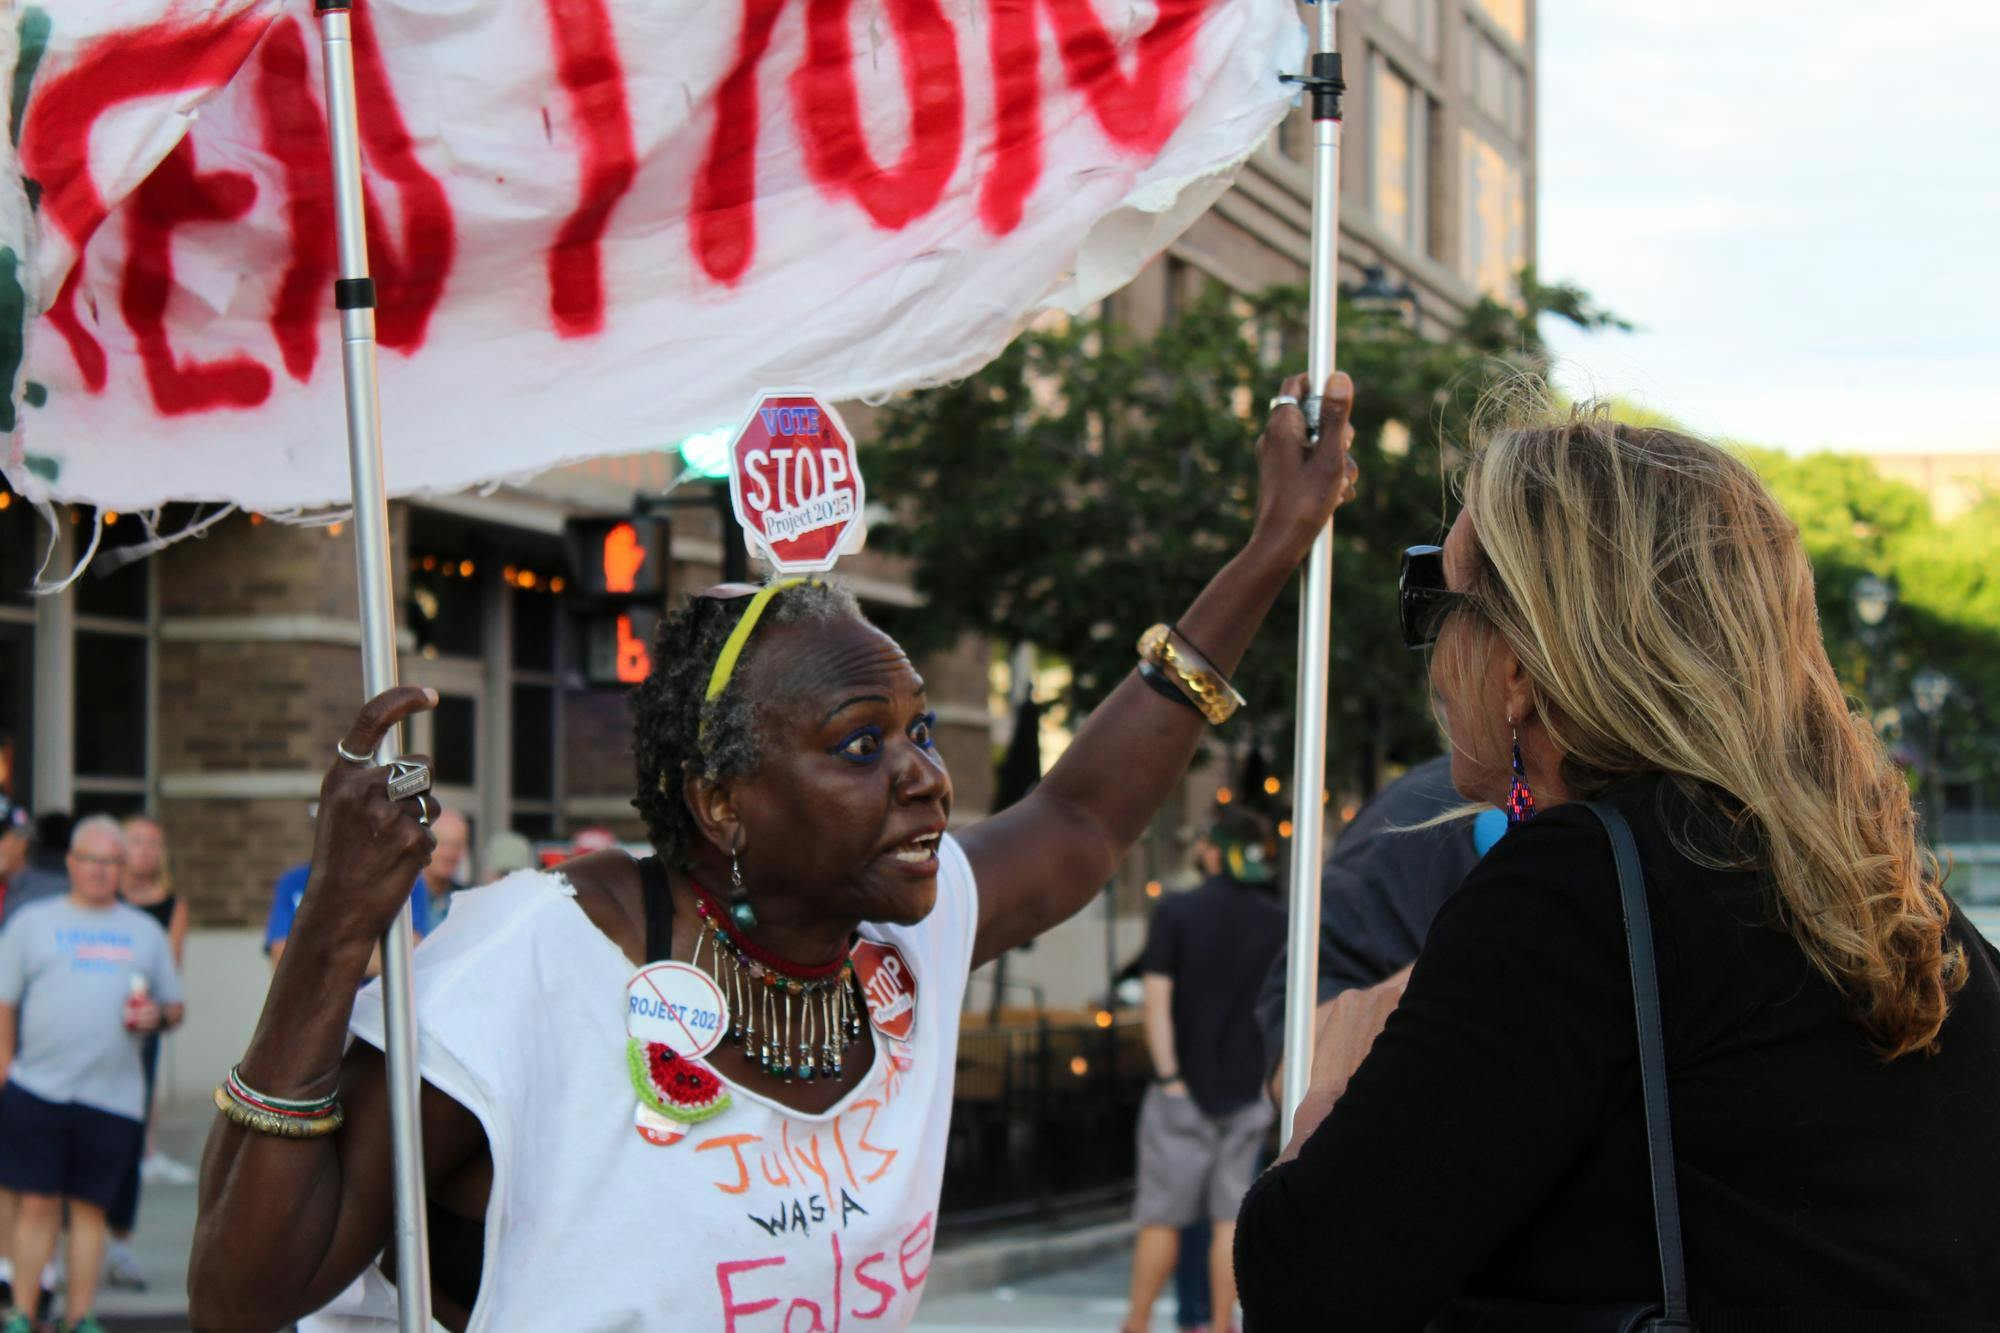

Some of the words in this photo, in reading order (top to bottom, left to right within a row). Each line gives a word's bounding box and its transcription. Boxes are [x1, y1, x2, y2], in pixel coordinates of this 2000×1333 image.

[760, 408, 819, 436] VOTE
[744, 447, 848, 512] STOP
[766, 508, 812, 537] Project
[813, 495, 850, 521] 2025
[628, 996, 688, 1022] ROJECT
[690, 1008, 724, 1031] 202
[748, 1195, 825, 1237] WAS
[840, 1188, 869, 1228] A
